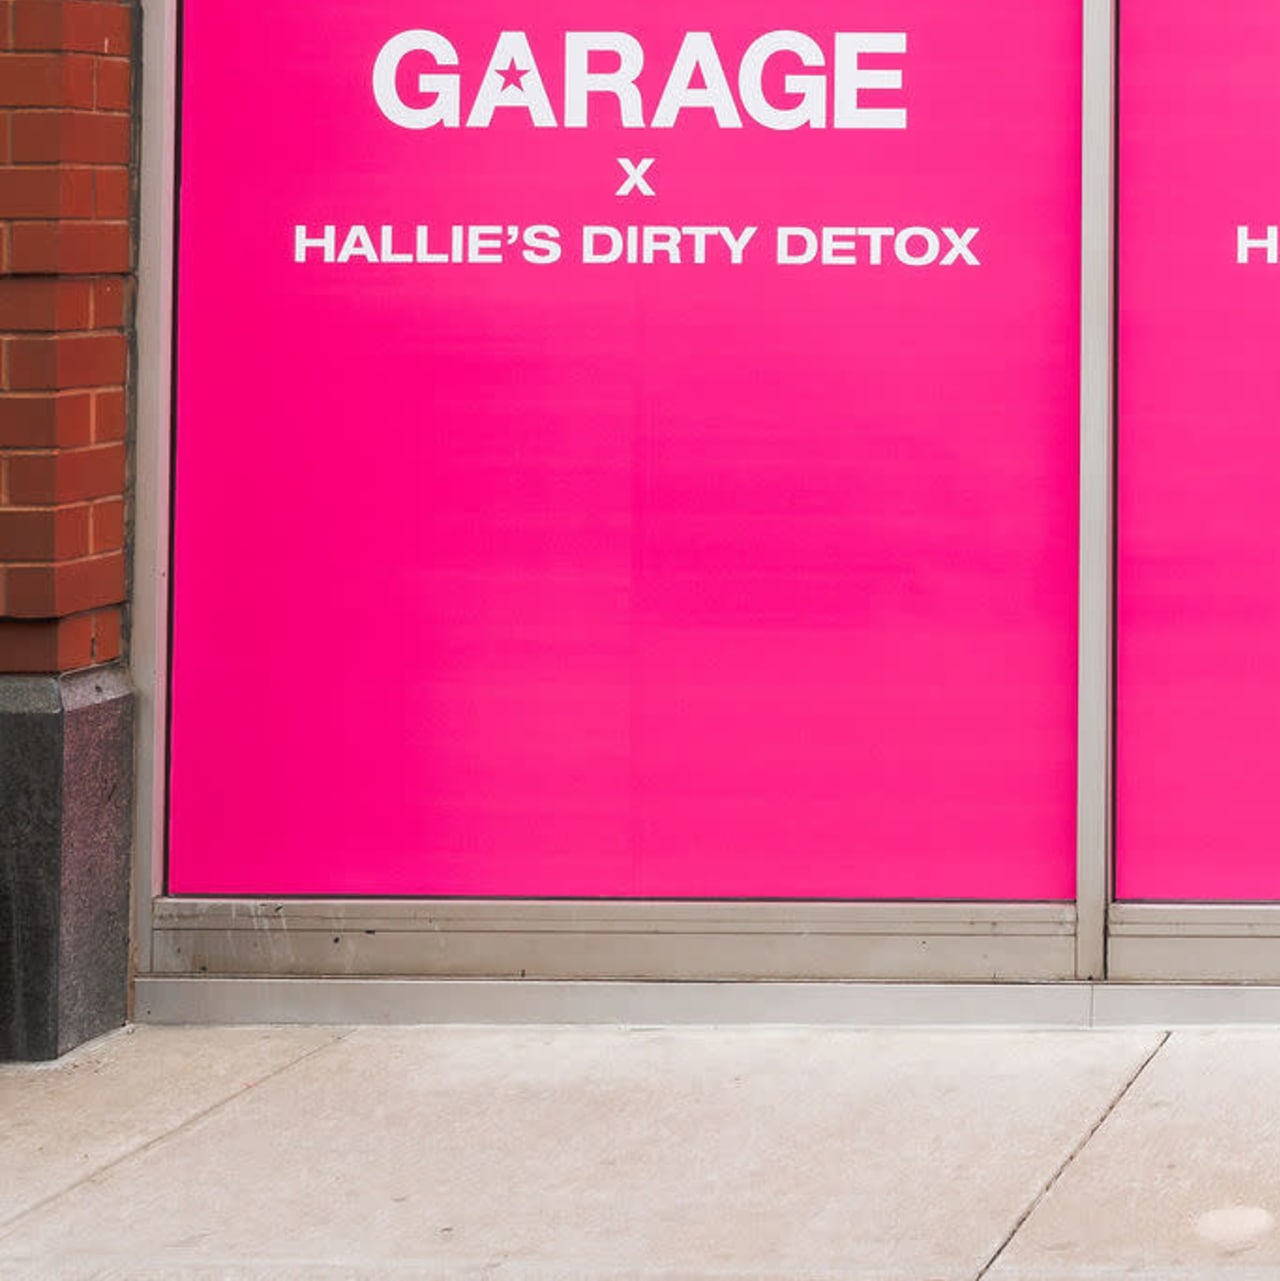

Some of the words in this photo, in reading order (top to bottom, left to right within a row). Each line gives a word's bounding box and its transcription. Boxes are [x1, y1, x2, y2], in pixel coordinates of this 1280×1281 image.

[372, 29, 908, 131] GARAGE
[294, 224, 562, 265] HALLIE’S
[582, 225, 758, 265] DIRTY
[776, 226, 981, 267] DETOX
